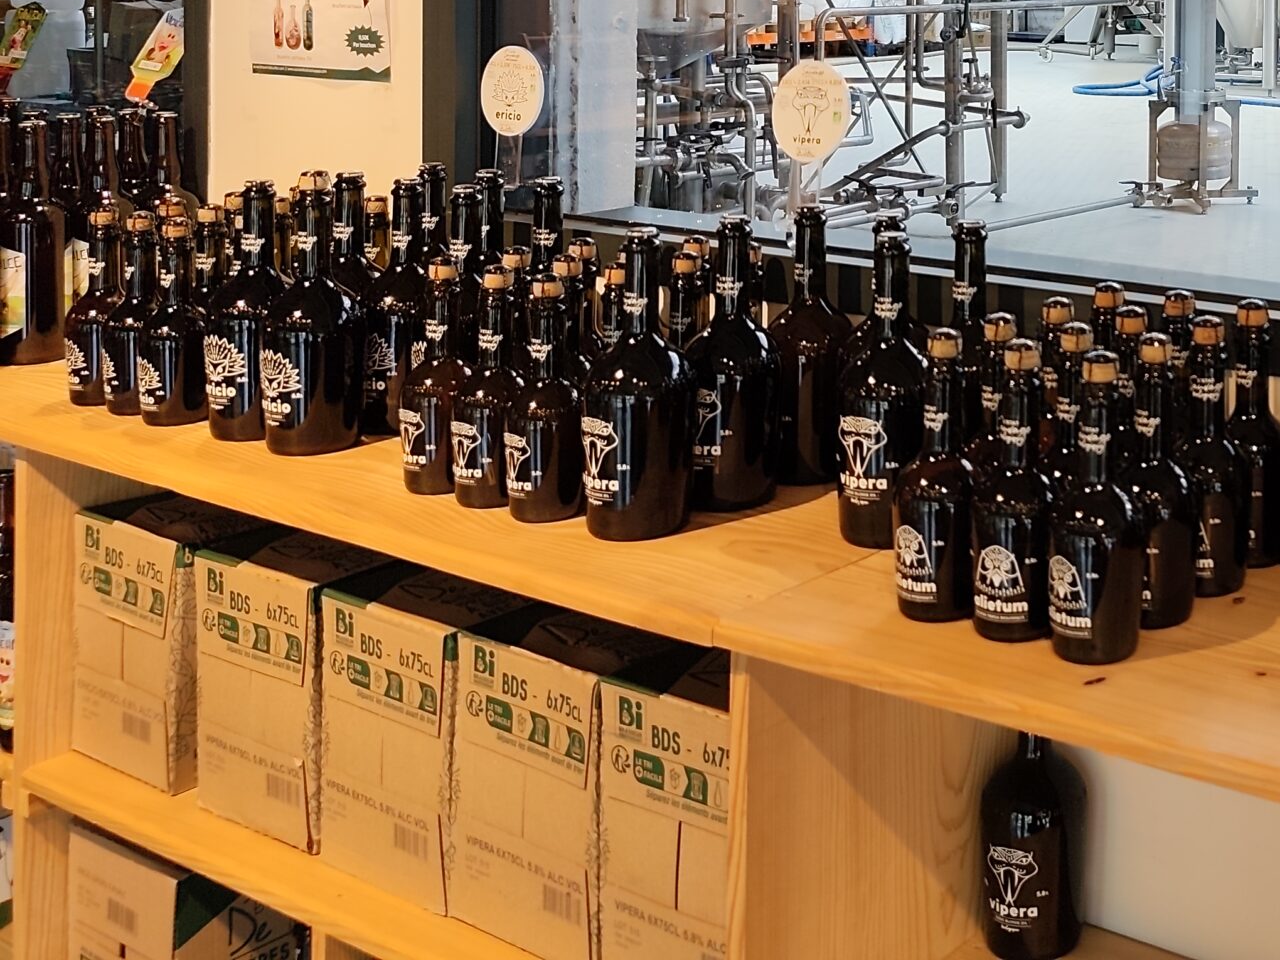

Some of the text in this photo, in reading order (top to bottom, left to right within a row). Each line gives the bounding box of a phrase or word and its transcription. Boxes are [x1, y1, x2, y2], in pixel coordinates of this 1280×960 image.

[495, 109, 521, 121] ericio
[793, 135, 821, 145] vipera
[840, 470, 888, 490] vipera
[85, 524, 100, 551] Bi
[105, 546, 124, 569] BDS
[207, 567, 224, 595] Bi
[229, 590, 250, 614] BDS
[335, 607, 354, 638] Bi
[360, 633, 382, 659] BDS
[474, 644, 495, 677] Bi
[502, 672, 528, 701] BDS
[618, 695, 643, 730] Bi
[651, 725, 681, 756] BDS
[326, 778, 351, 796] VIPERA
[466, 834, 495, 854] VIPERA
[548, 871, 564, 886] ALC
[566, 879, 583, 895] VOL
[989, 897, 1038, 917] vipera
[227, 906, 272, 957] De
[615, 899, 645, 921] VIPERA
[707, 939, 727, 954] ALC
